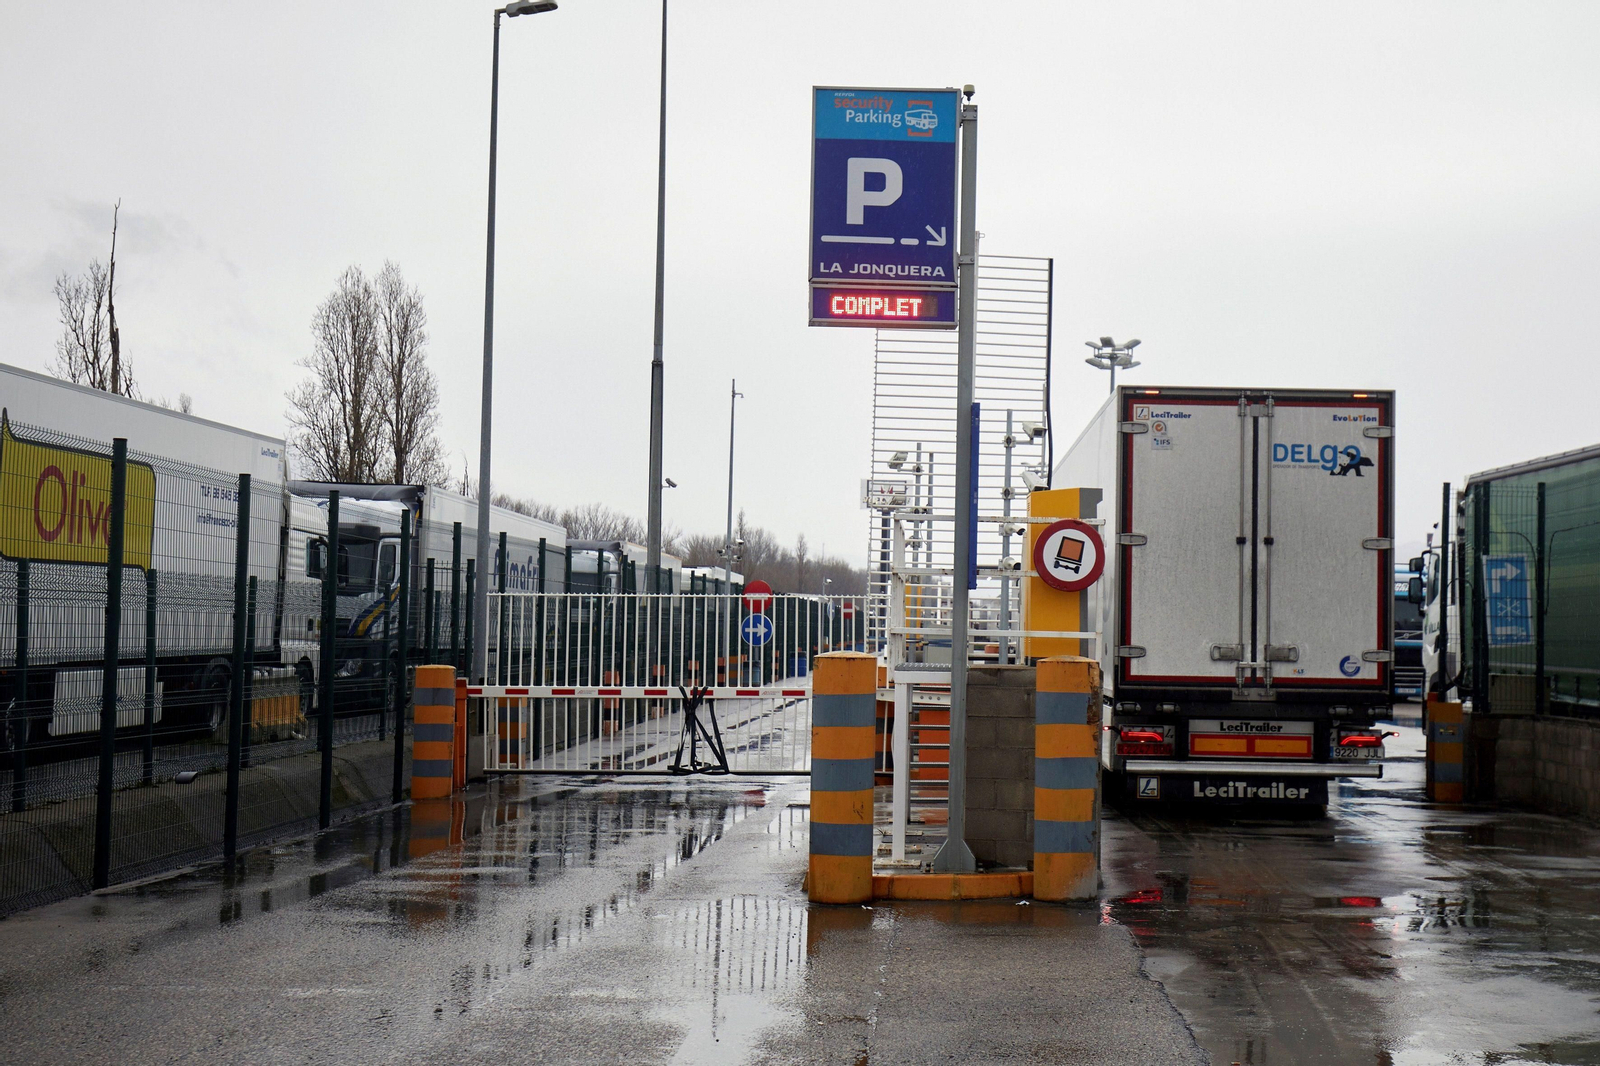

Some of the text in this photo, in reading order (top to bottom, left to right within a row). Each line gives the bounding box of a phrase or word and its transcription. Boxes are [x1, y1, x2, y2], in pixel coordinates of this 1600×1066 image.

[834, 95, 893, 113] security
[846, 109, 902, 128] Parking
[846, 157, 904, 225] P
[820, 262, 946, 277] LA JONQUERA
[831, 295, 922, 317] COMPLET
[1150, 411, 1192, 419] LeciTrailer
[1219, 721, 1283, 733] LeciTrailer
[1335, 747, 1359, 757] 9220
[1193, 781, 1310, 799] LeciTrailer
